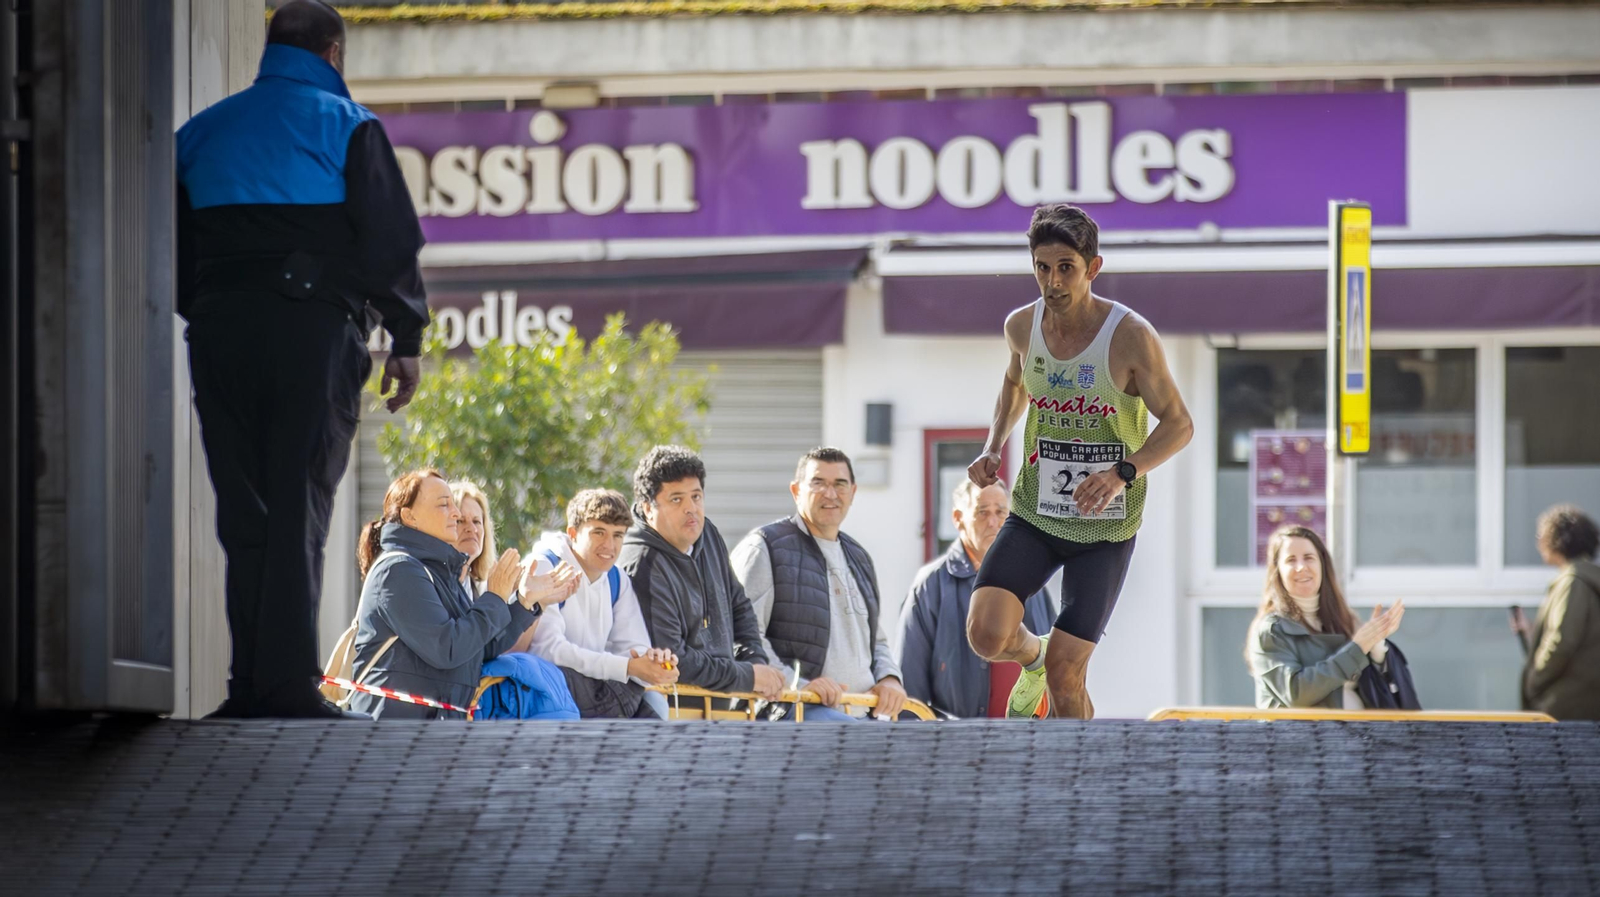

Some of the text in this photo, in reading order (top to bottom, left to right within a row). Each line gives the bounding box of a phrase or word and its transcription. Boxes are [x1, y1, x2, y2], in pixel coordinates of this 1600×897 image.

[800, 101, 1236, 210] noodles
[1038, 413, 1099, 429] JEREZ
[1043, 450, 1121, 462] POPULAR JEREZ
[1071, 445, 1121, 454] CARRERA
[1039, 501, 1060, 514] enjoy!
